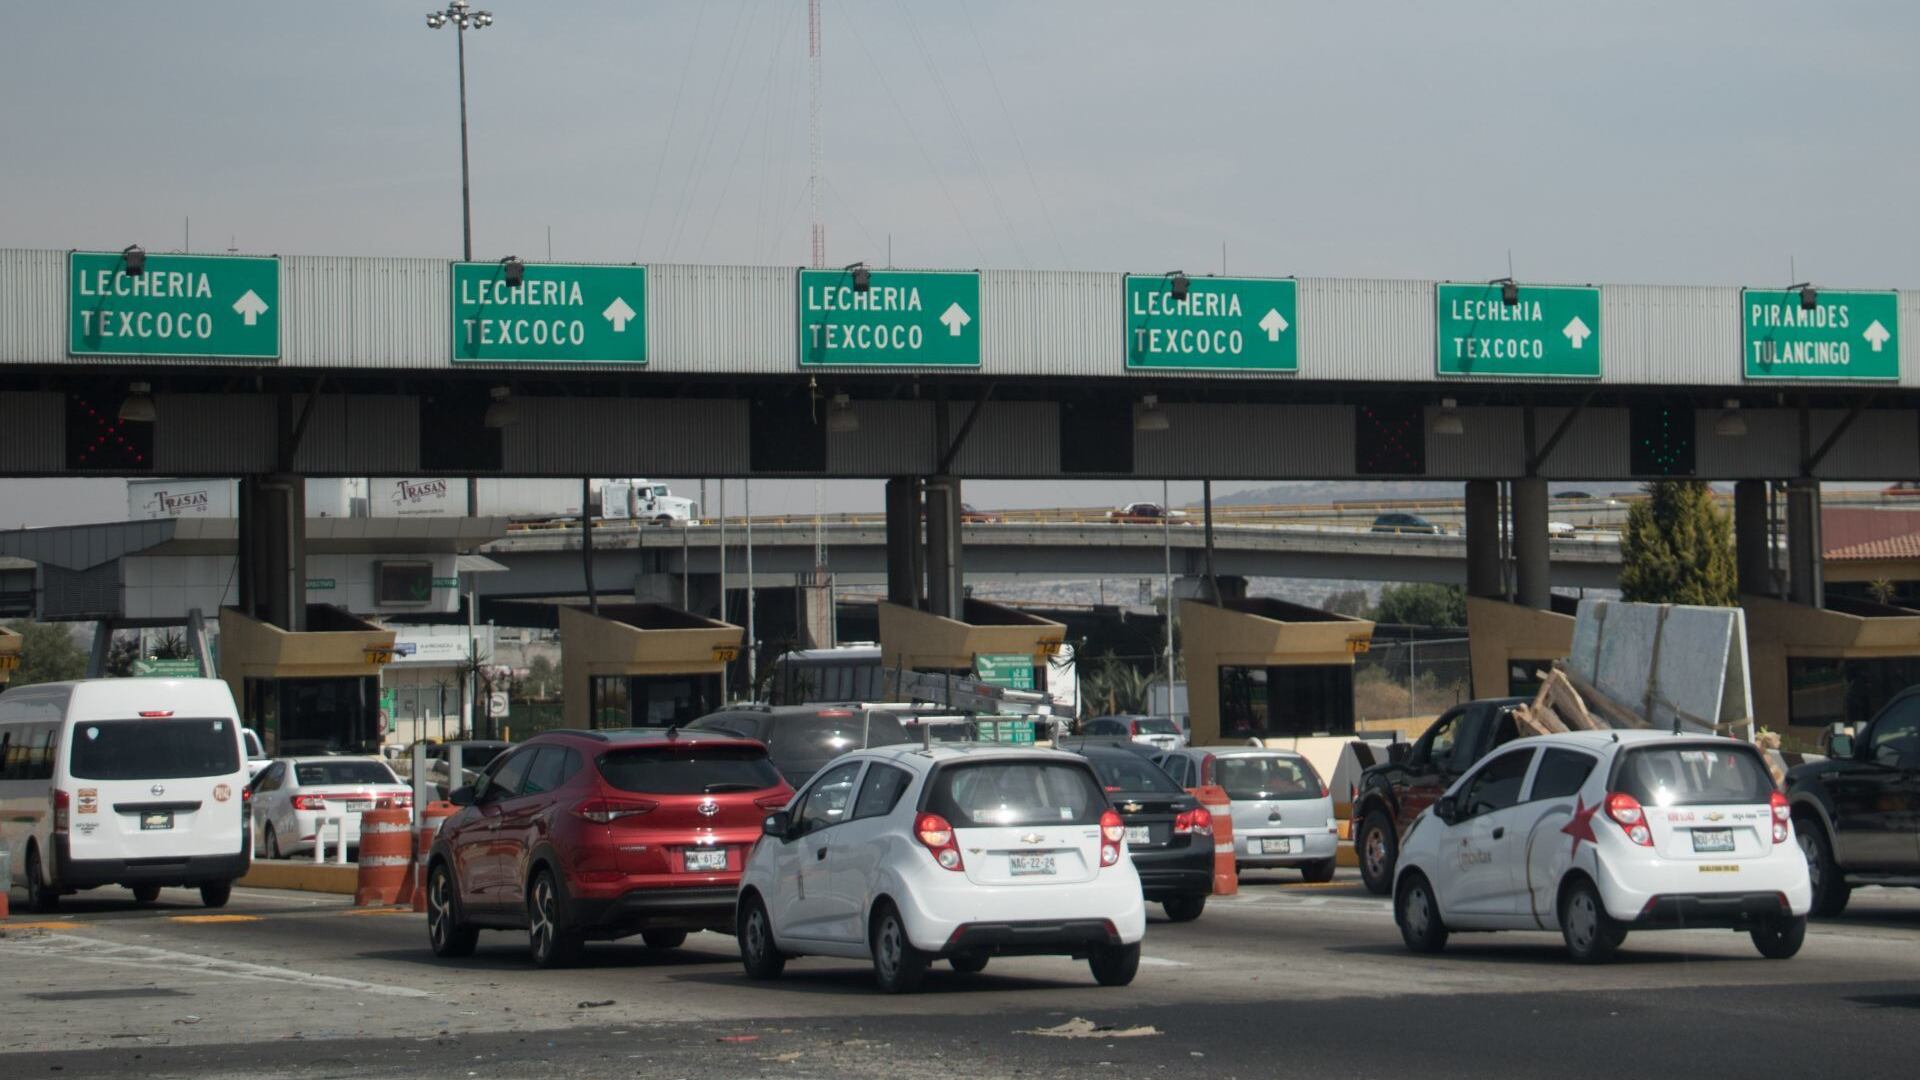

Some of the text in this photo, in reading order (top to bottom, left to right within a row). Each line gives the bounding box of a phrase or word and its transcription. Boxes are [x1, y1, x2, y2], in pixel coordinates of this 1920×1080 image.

[80, 269, 212, 298] LECHERIA
[462, 279, 584, 305] LECHERIA
[808, 286, 922, 311] LECHERIA
[1134, 291, 1242, 317] LECHERIA
[1452, 299, 1543, 322] LECHERIA
[80, 310, 213, 339] TEXCOCO
[1752, 303, 1850, 329] PIRAMIDES
[463, 319, 585, 345] TEXCOCO
[808, 324, 923, 349] TEXCOCO
[1134, 329, 1243, 354] TEXCOCO
[1453, 337, 1543, 359] TEXCOCO
[1752, 340, 1850, 366] TULANCINGO
[154, 490, 208, 512] TRASAN
[396, 480, 448, 500] TRASAN
